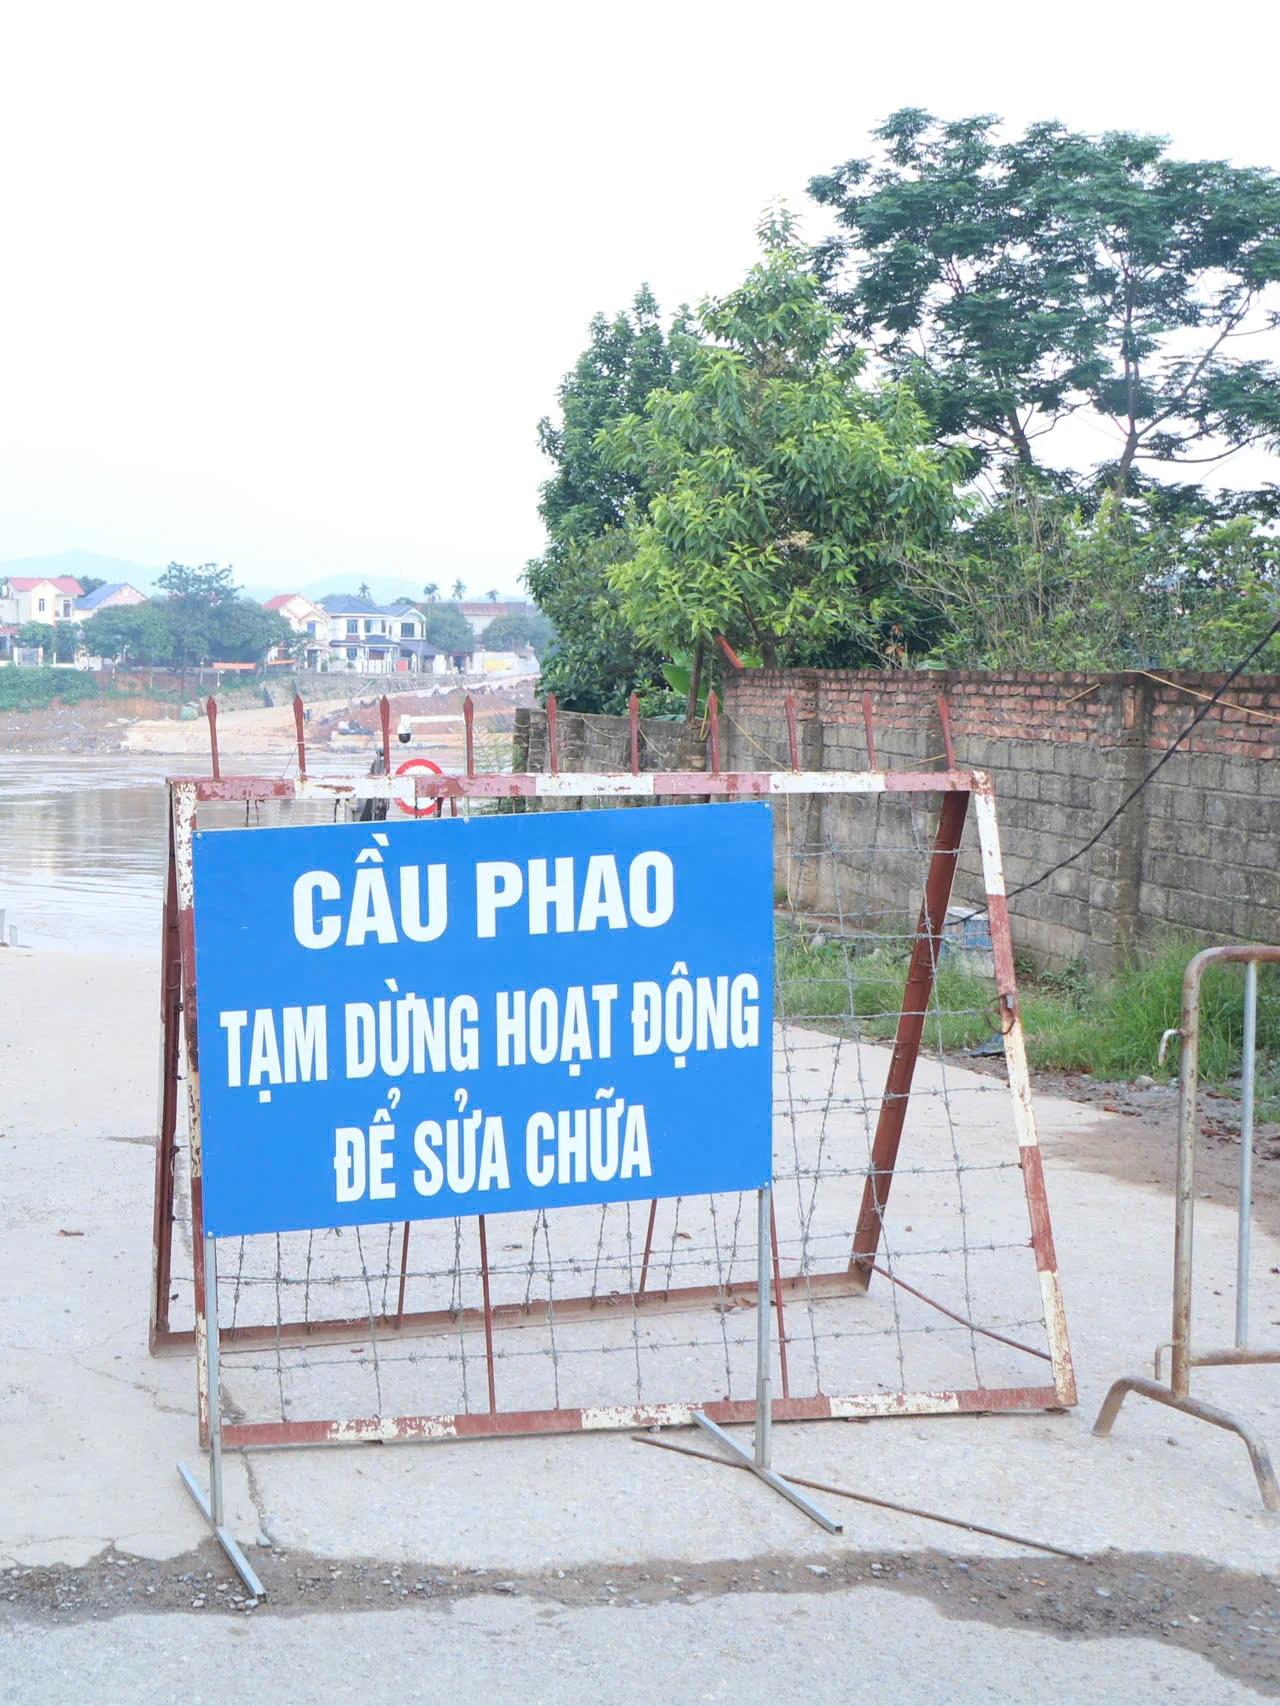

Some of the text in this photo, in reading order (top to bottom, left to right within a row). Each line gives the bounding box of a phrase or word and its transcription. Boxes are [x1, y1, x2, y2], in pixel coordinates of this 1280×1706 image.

[293, 833, 675, 949] CẦU PHAO
[220, 961, 760, 1103] TẠM DỪNG HOẠT ĐỘNG
[333, 1086, 653, 1203] ĐỂ SỬA CHỮA
